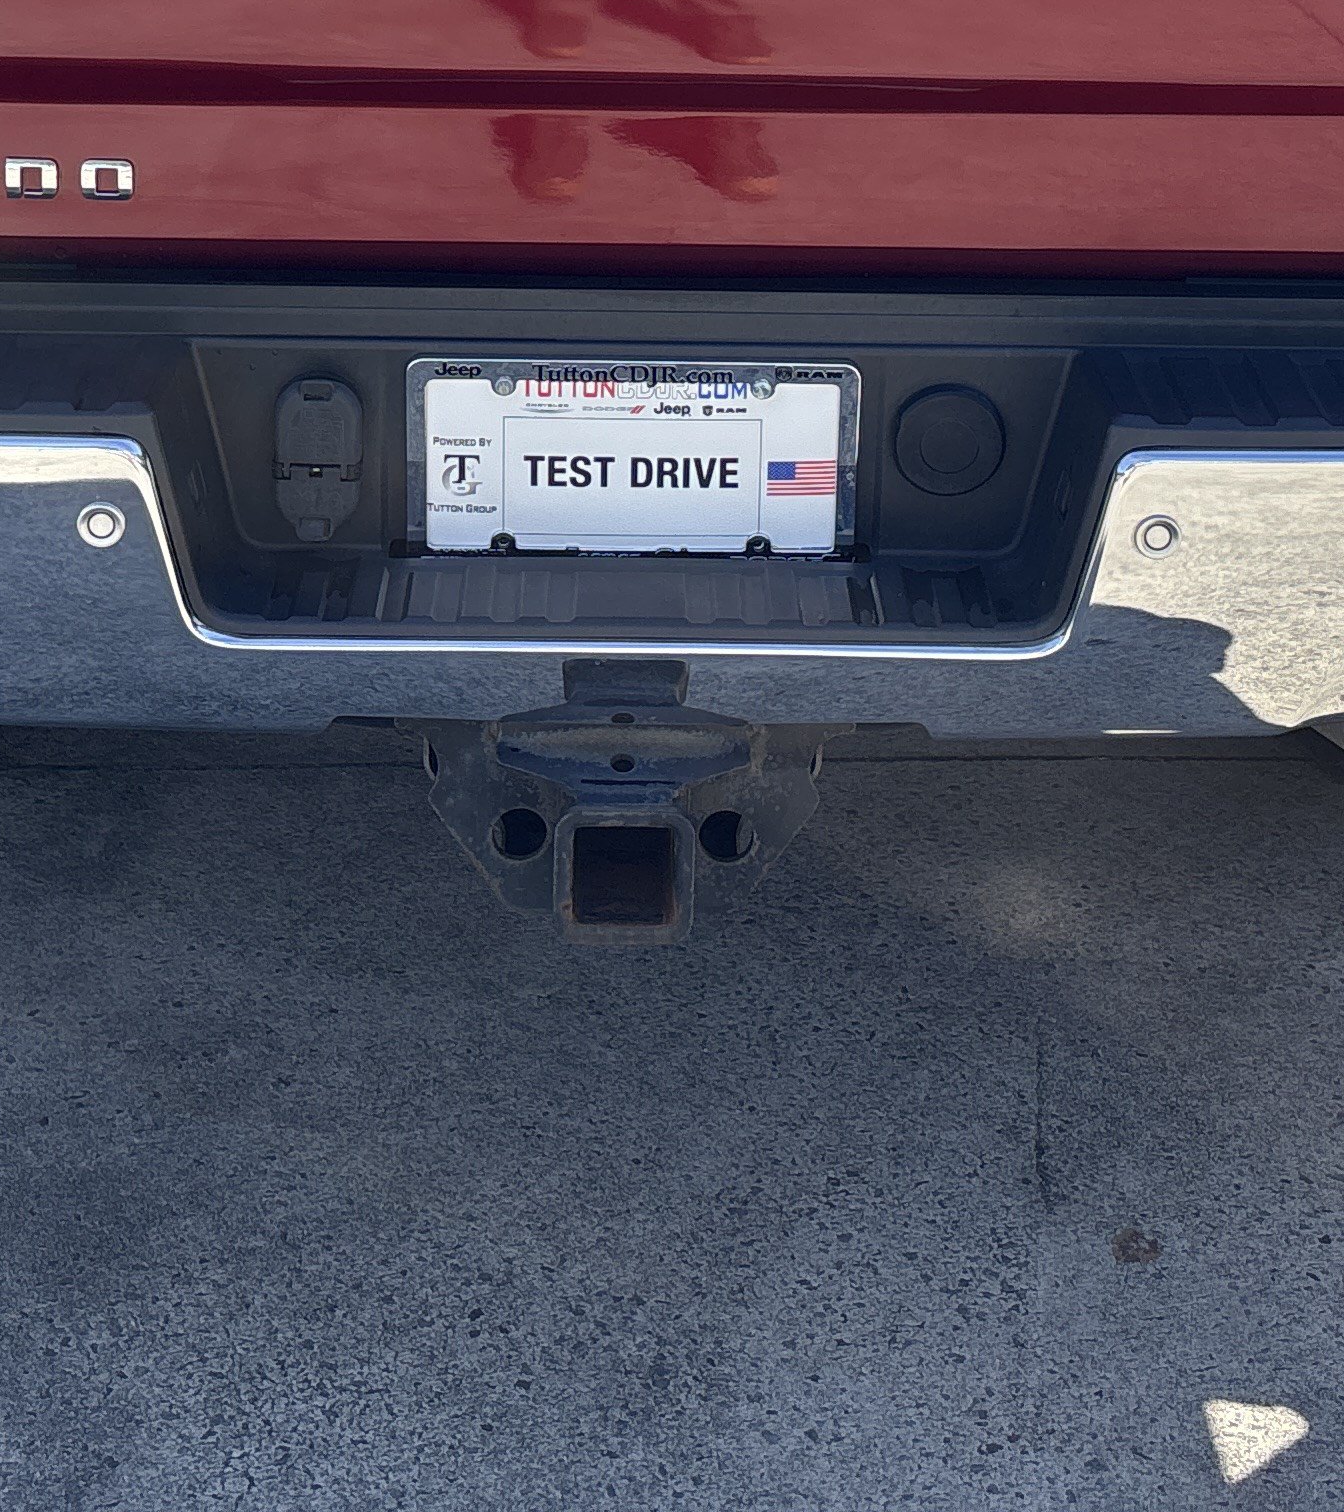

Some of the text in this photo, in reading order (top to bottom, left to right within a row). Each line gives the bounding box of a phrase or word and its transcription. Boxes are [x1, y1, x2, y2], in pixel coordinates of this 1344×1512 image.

[434, 362, 482, 379] Jeep
[532, 364, 734, 388] TuttonCDJR.com
[795, 370, 844, 380] RAM
[654, 402, 691, 417] Jeep
[523, 455, 740, 489] TEST DRIVE
